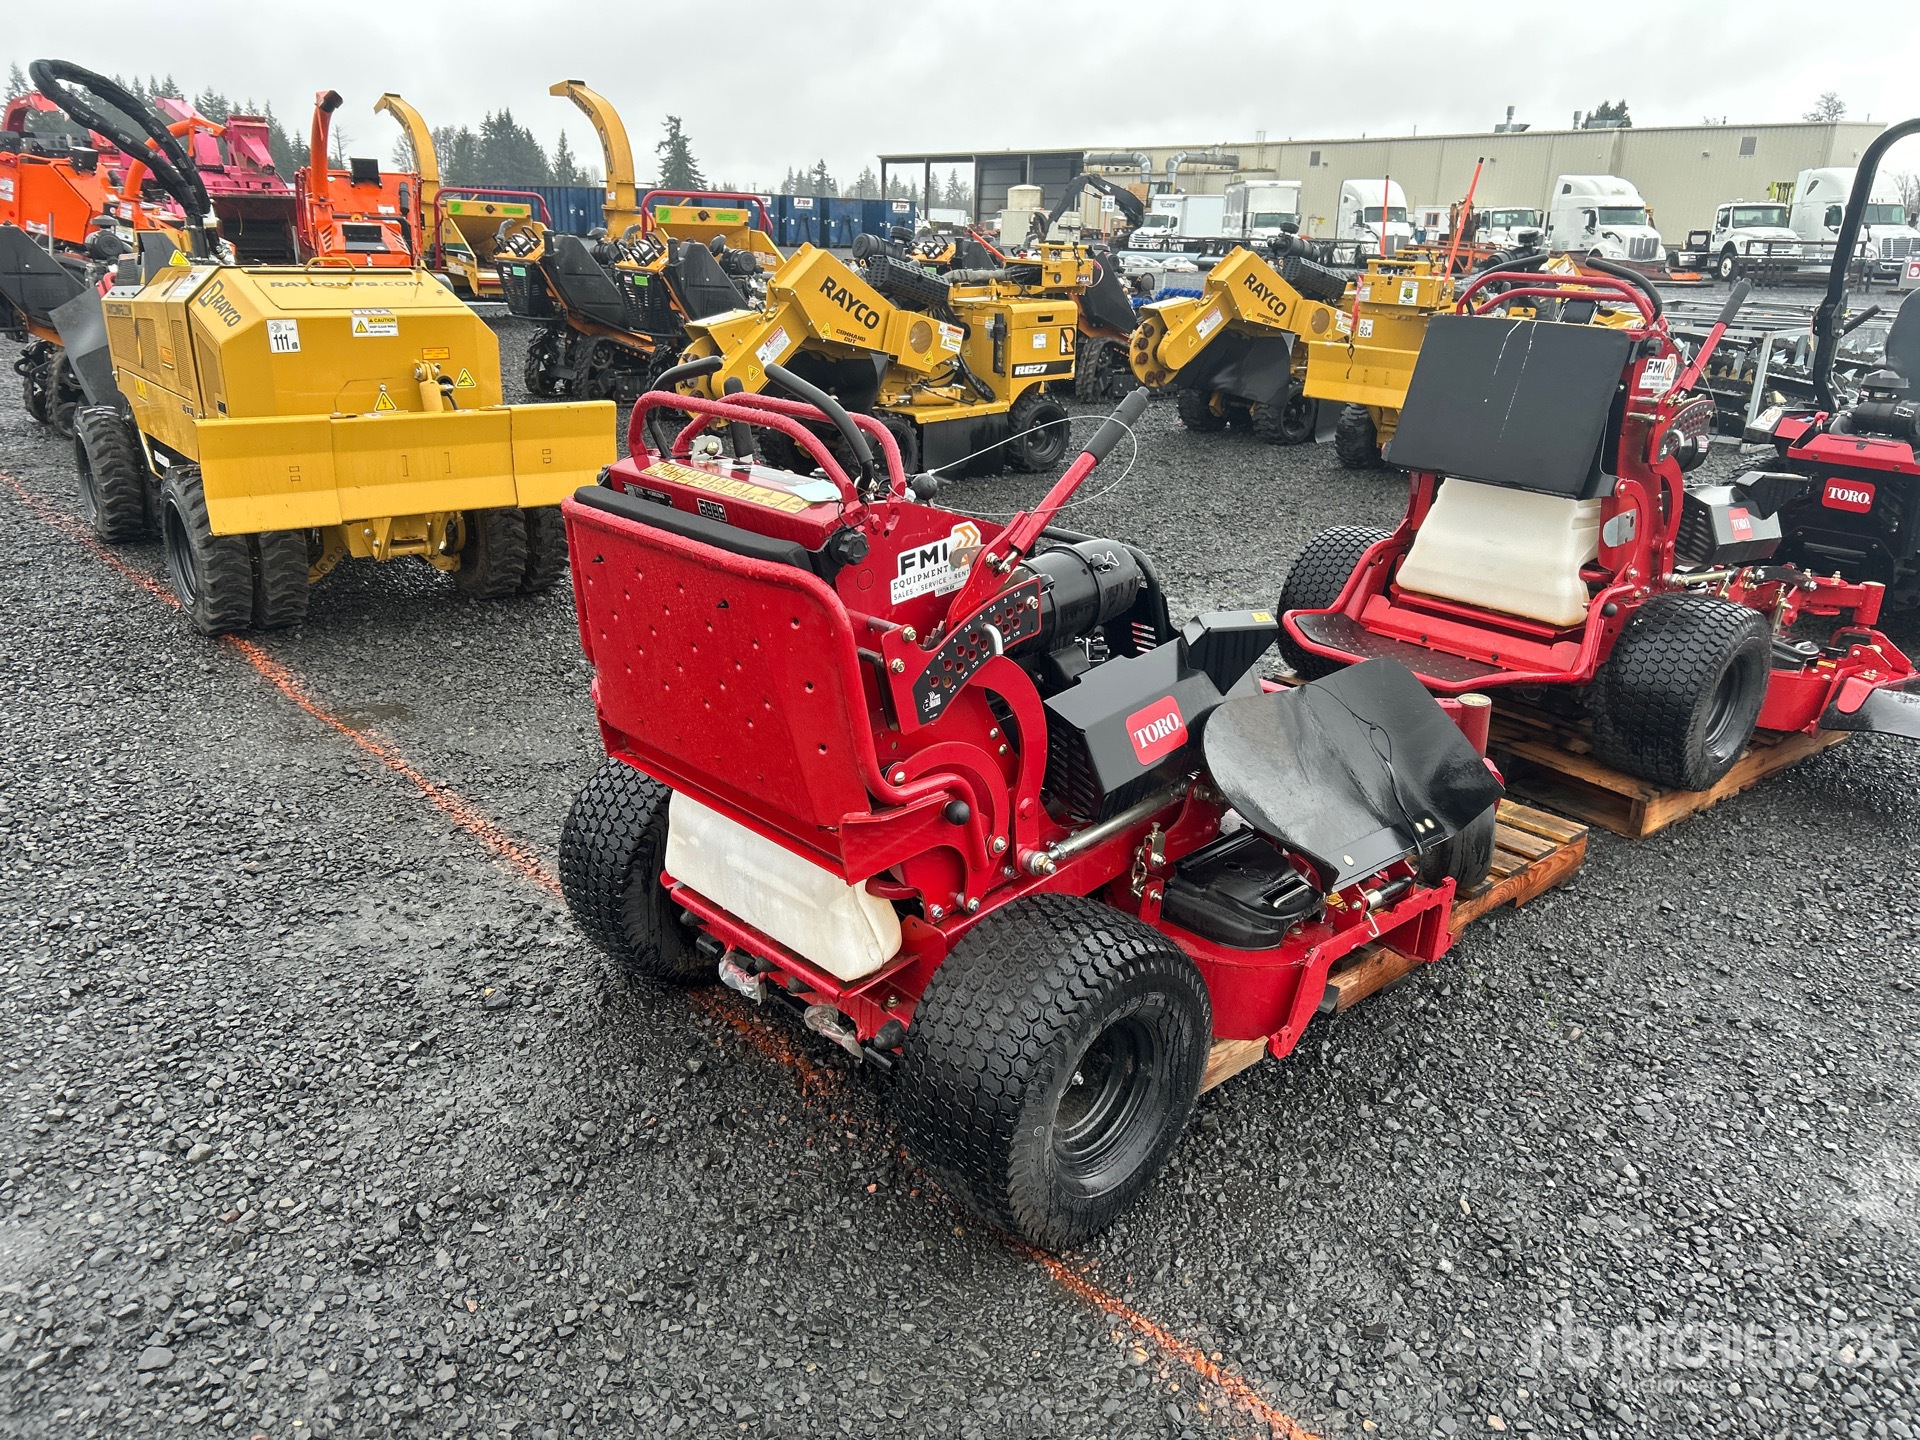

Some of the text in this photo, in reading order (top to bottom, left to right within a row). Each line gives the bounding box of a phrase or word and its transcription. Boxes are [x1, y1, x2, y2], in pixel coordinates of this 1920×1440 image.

[819, 275, 880, 330] RAYCO
[1243, 272, 1287, 317] RAYCO
[210, 294, 242, 328] RAYCO
[273, 334, 290, 350] 111
[1359, 327, 1368, 336] 93
[1014, 364, 1048, 375] RG27
[1646, 361, 1666, 373] FMI
[1828, 486, 1870, 504] TORO
[1732, 518, 1750, 530] TORO
[900, 542, 948, 576] FMI
[893, 564, 949, 590] EQUIPMENT
[893, 589, 914, 601] SALES
[921, 576, 947, 591] SERVICE
[1133, 712, 1180, 749] TORO
